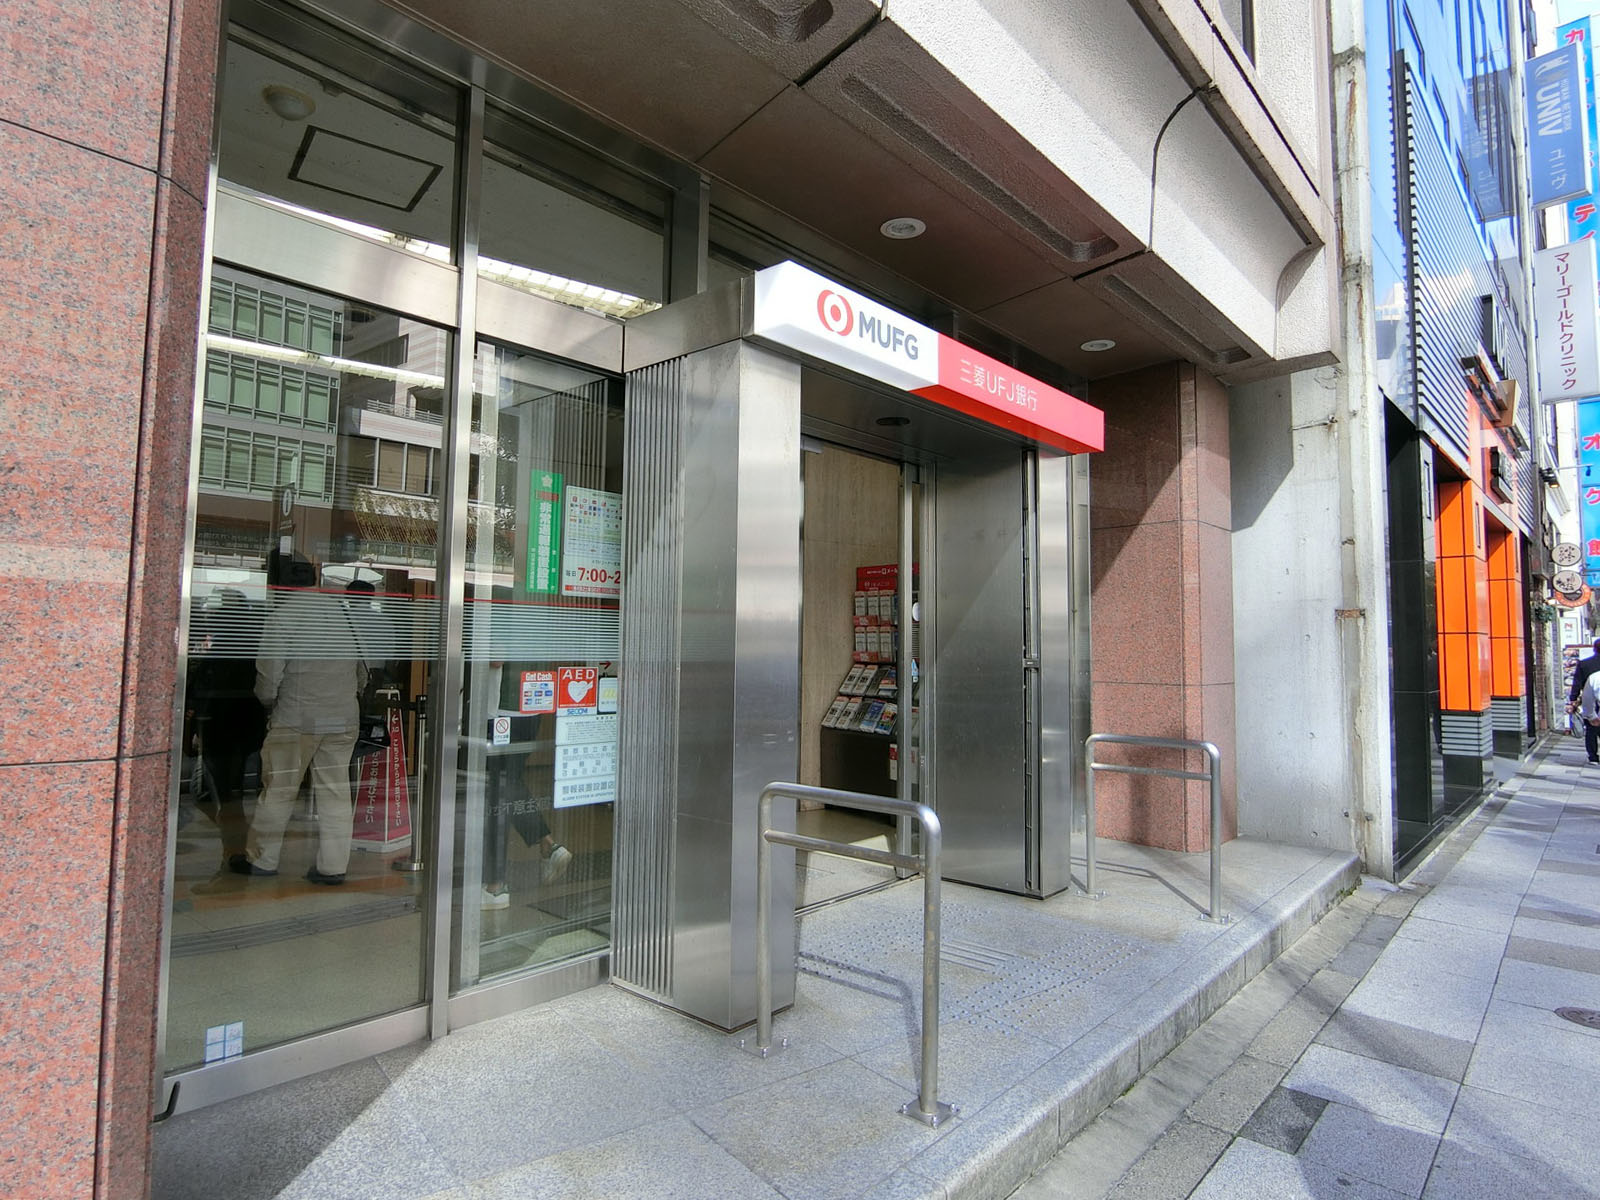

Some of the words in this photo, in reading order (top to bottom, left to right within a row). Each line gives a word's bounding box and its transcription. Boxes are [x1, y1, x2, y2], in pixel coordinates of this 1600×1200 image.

[858, 311, 919, 361] MUFG
[1554, 252, 1576, 390] マリーゴールドクリニック
[959, 358, 1038, 412] 三菱UFJ銀行
[562, 669, 595, 680] AED
